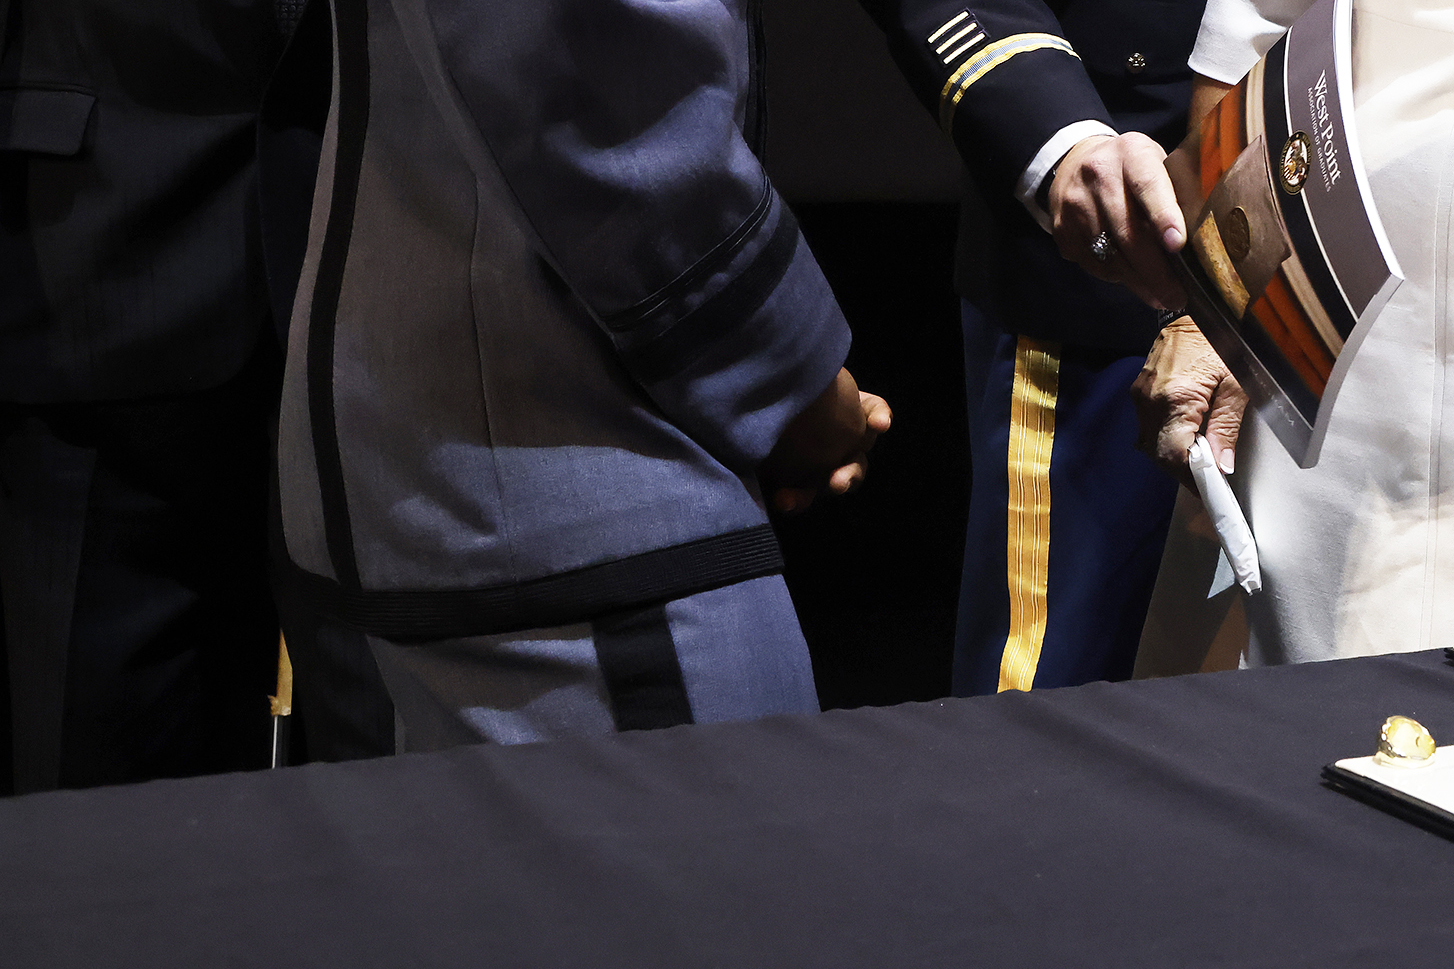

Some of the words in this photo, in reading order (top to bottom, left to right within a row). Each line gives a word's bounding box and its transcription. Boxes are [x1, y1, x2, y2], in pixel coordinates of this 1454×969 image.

[1307, 87, 1319, 136] ASSOCIATION
[1314, 69, 1330, 127] West
[1314, 135, 1322, 146] OF
[1321, 121, 1341, 185] Point
[1316, 146, 1332, 193] GRADUATES
